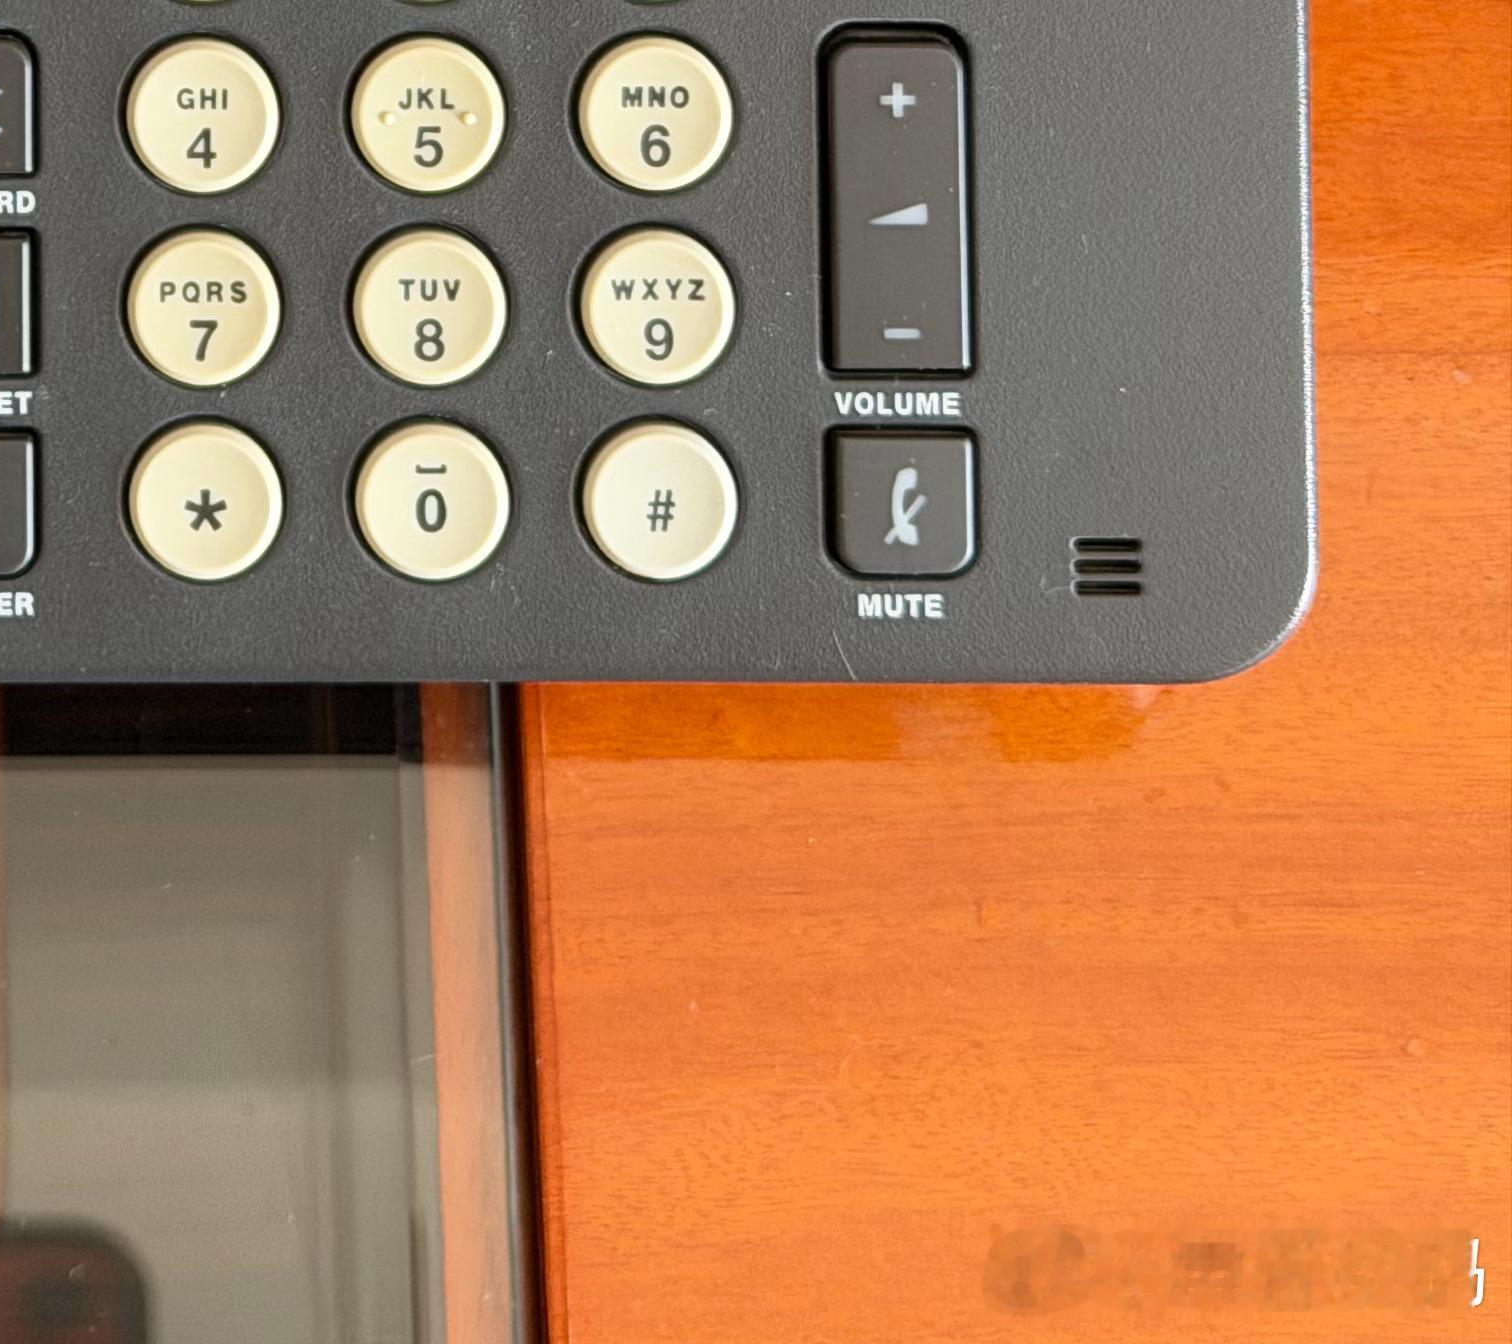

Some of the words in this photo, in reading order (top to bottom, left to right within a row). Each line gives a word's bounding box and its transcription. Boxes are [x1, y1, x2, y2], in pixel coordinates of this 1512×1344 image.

[177, 88, 228, 110] GHI
[399, 88, 455, 110] JKL
[622, 86, 689, 108] MNO
[187, 128, 216, 168] 4
[415, 126, 443, 167] 5
[641, 125, 670, 167] 6
[160, 281, 247, 303] PQRS
[399, 279, 460, 301] TUV
[612, 279, 705, 301] WXYZ
[190, 320, 218, 361] 7
[415, 319, 444, 361] 8
[645, 319, 673, 360] 9
[835, 392, 960, 416] VOLUME
[416, 489, 446, 532] 0
[647, 490, 675, 531] #
[858, 594, 943, 618] MUTE
